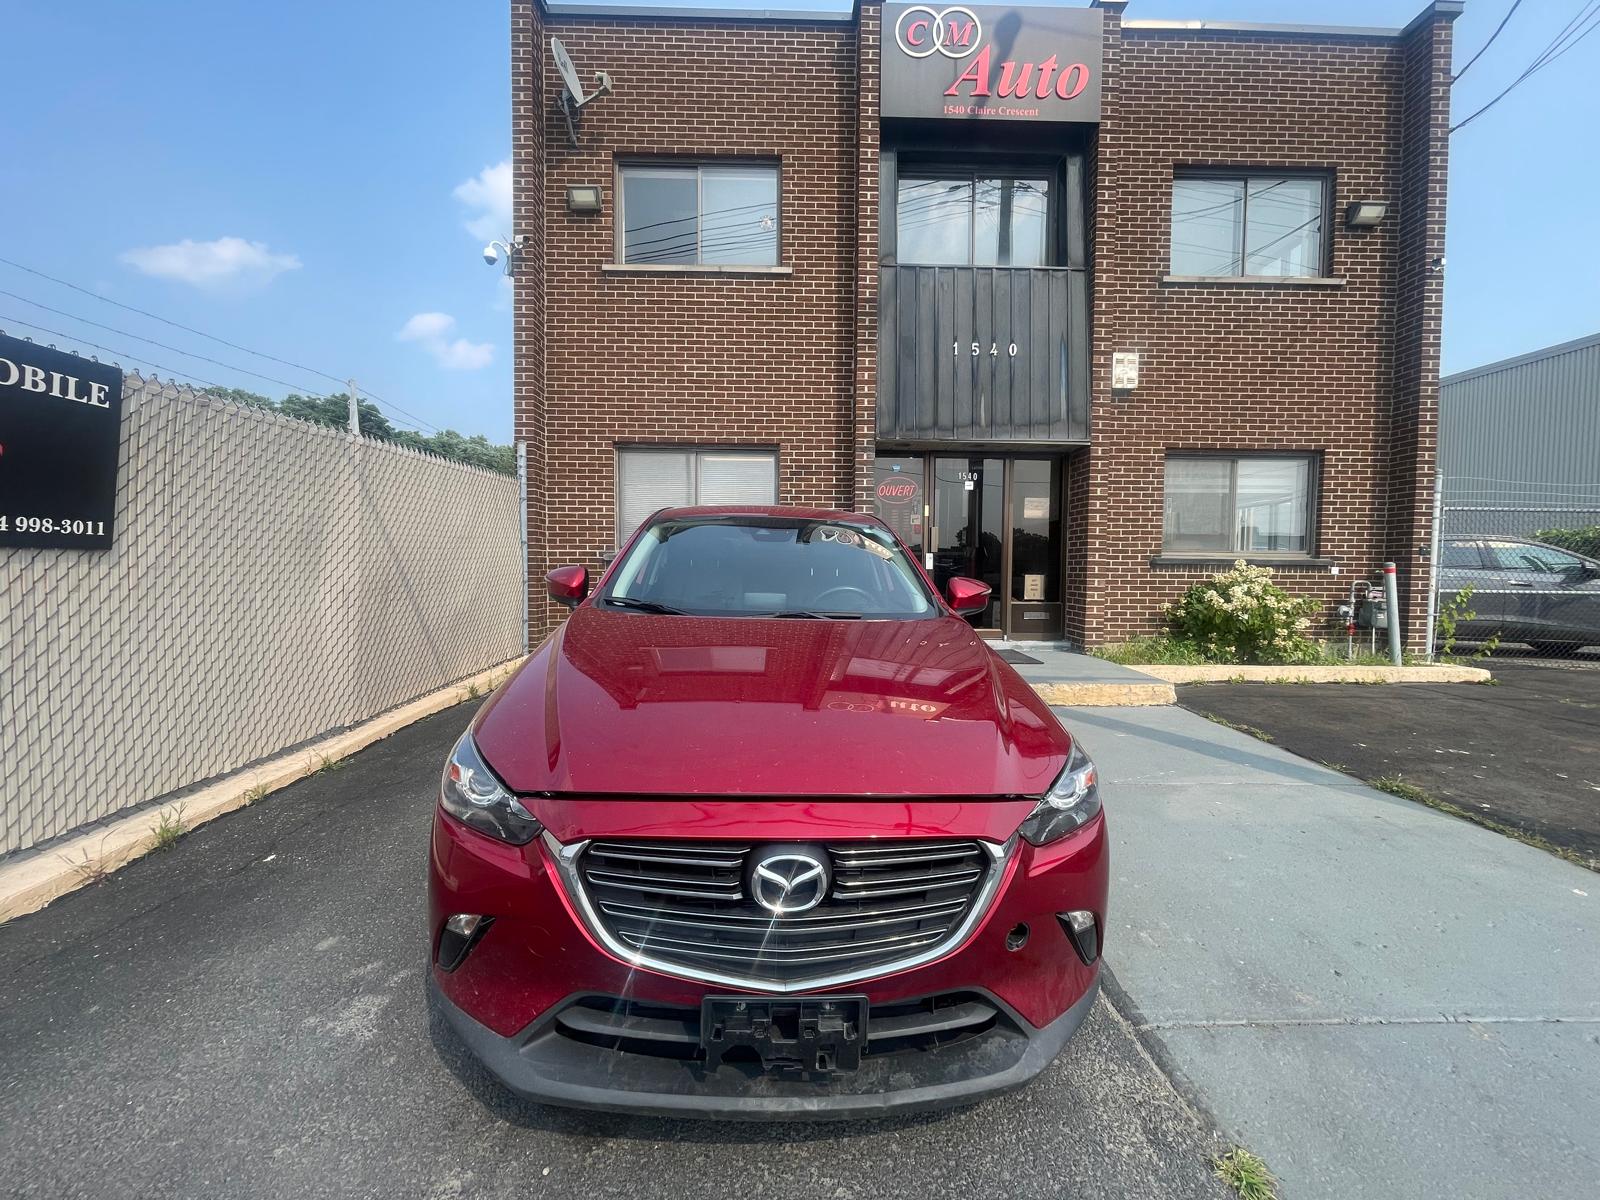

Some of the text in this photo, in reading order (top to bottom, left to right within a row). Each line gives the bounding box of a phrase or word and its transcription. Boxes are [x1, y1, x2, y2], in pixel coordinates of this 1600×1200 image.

[906, 20, 976, 47] C M
[943, 44, 1090, 100] Auto
[943, 105, 1039, 117] 1540 Claire Crescent
[953, 341, 1018, 356] 1540
[958, 472, 978, 481] 1540
[878, 484, 916, 497] OUVERT
[15, 516, 105, 536] 998-3011
